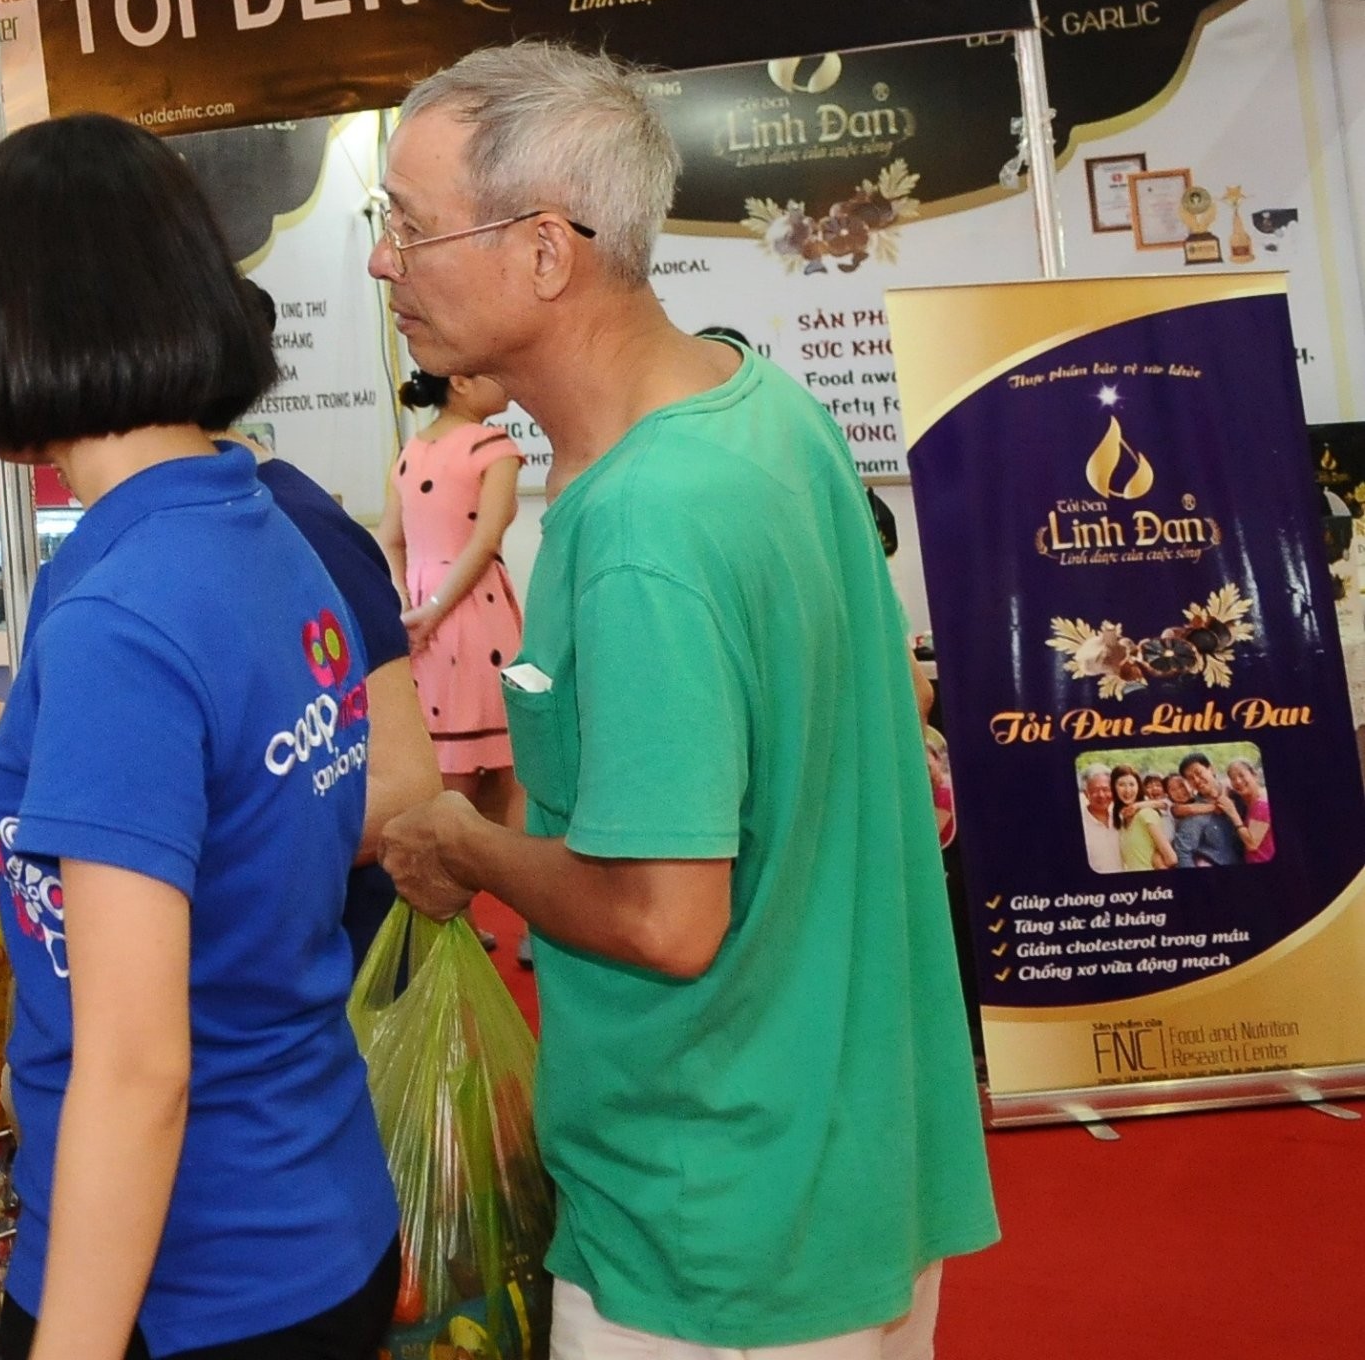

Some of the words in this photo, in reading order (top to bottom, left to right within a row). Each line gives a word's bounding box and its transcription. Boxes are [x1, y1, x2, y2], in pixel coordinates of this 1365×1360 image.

[1061, 0, 1161, 36] GARLIC
[727, 110, 807, 152] Linh
[816, 104, 898, 143] Đan
[798, 307, 844, 332] SẢN
[801, 338, 844, 360] SỨC
[805, 370, 854, 387] Food
[1049, 510, 1124, 550] Linh
[1133, 510, 1206, 545] Đan
[990, 710, 1055, 746] Tỏi
[1060, 709, 1132, 741] Đen
[1139, 703, 1227, 736] Linh
[1231, 698, 1313, 730] Đan
[1010, 894, 1051, 912] Giúp
[1109, 891, 1138, 905] oxy
[1141, 885, 1174, 902] hóa
[1013, 919, 1055, 937] Tăng
[1090, 910, 1111, 929] đề
[1114, 911, 1167, 931] kháng
[1016, 941, 1062, 959] Giảm
[1065, 934, 1158, 955] cholesterol
[1160, 932, 1207, 951] trong
[1211, 928, 1250, 945] máu
[1017, 962, 1073, 983] Chống
[1136, 954, 1178, 974] động
[1181, 952, 1231, 973] mạch
[1168, 1023, 1206, 1046] Food
[1209, 1021, 1238, 1043] and
[1240, 1019, 1300, 1040] Nutrition
[1093, 1028, 1157, 1074] FNC
[1171, 1044, 1240, 1067] Research
[1243, 1043, 1289, 1062] Center
